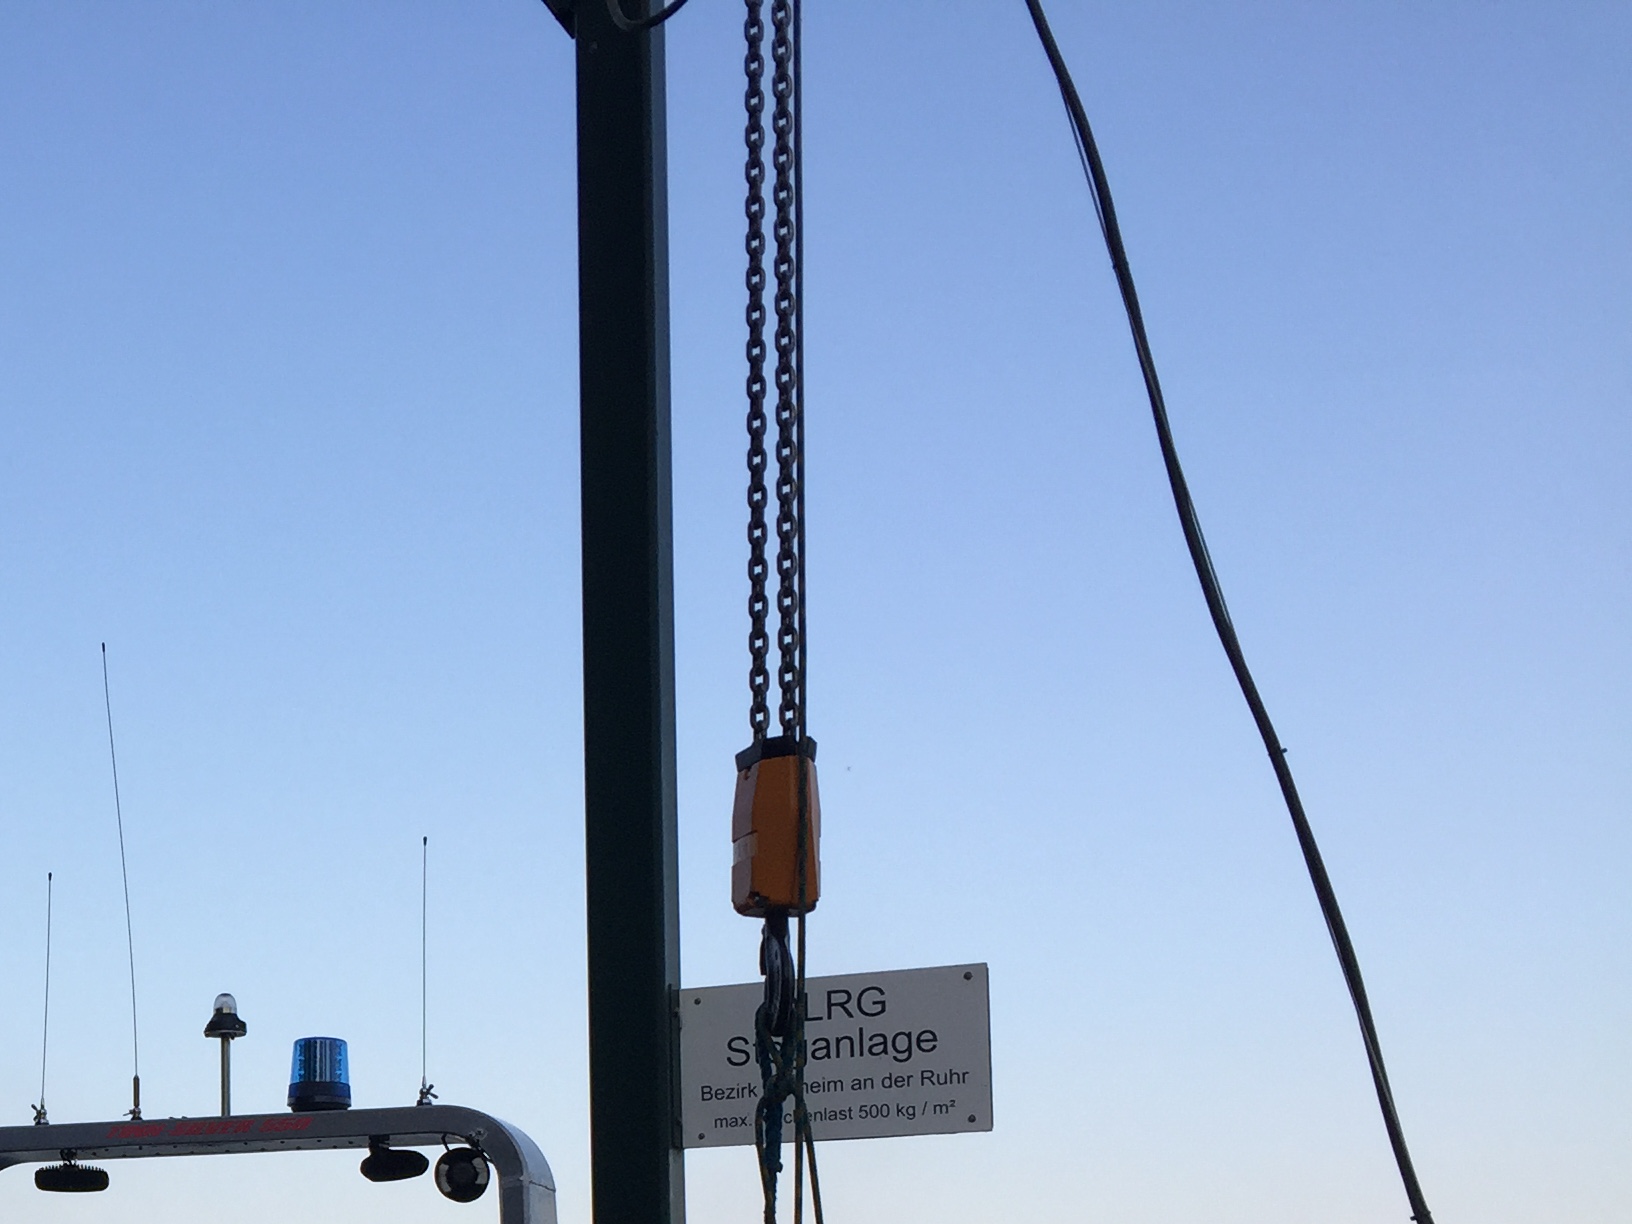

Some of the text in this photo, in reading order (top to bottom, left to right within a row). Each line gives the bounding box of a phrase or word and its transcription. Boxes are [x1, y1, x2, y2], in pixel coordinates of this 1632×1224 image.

[803, 985, 887, 1022] LRG
[726, 1027, 939, 1068] Sanlage
[700, 1082, 759, 1102] Bezirk
[850, 1077, 875, 1091] an
[881, 1072, 914, 1089] der
[920, 1068, 970, 1087] Ruhr
[713, 1115, 754, 1129] max.
[858, 1103, 891, 1120] 500
[896, 1102, 917, 1121] kg
[921, 1101, 928, 1116] /
[933, 1099, 956, 1115] m²
